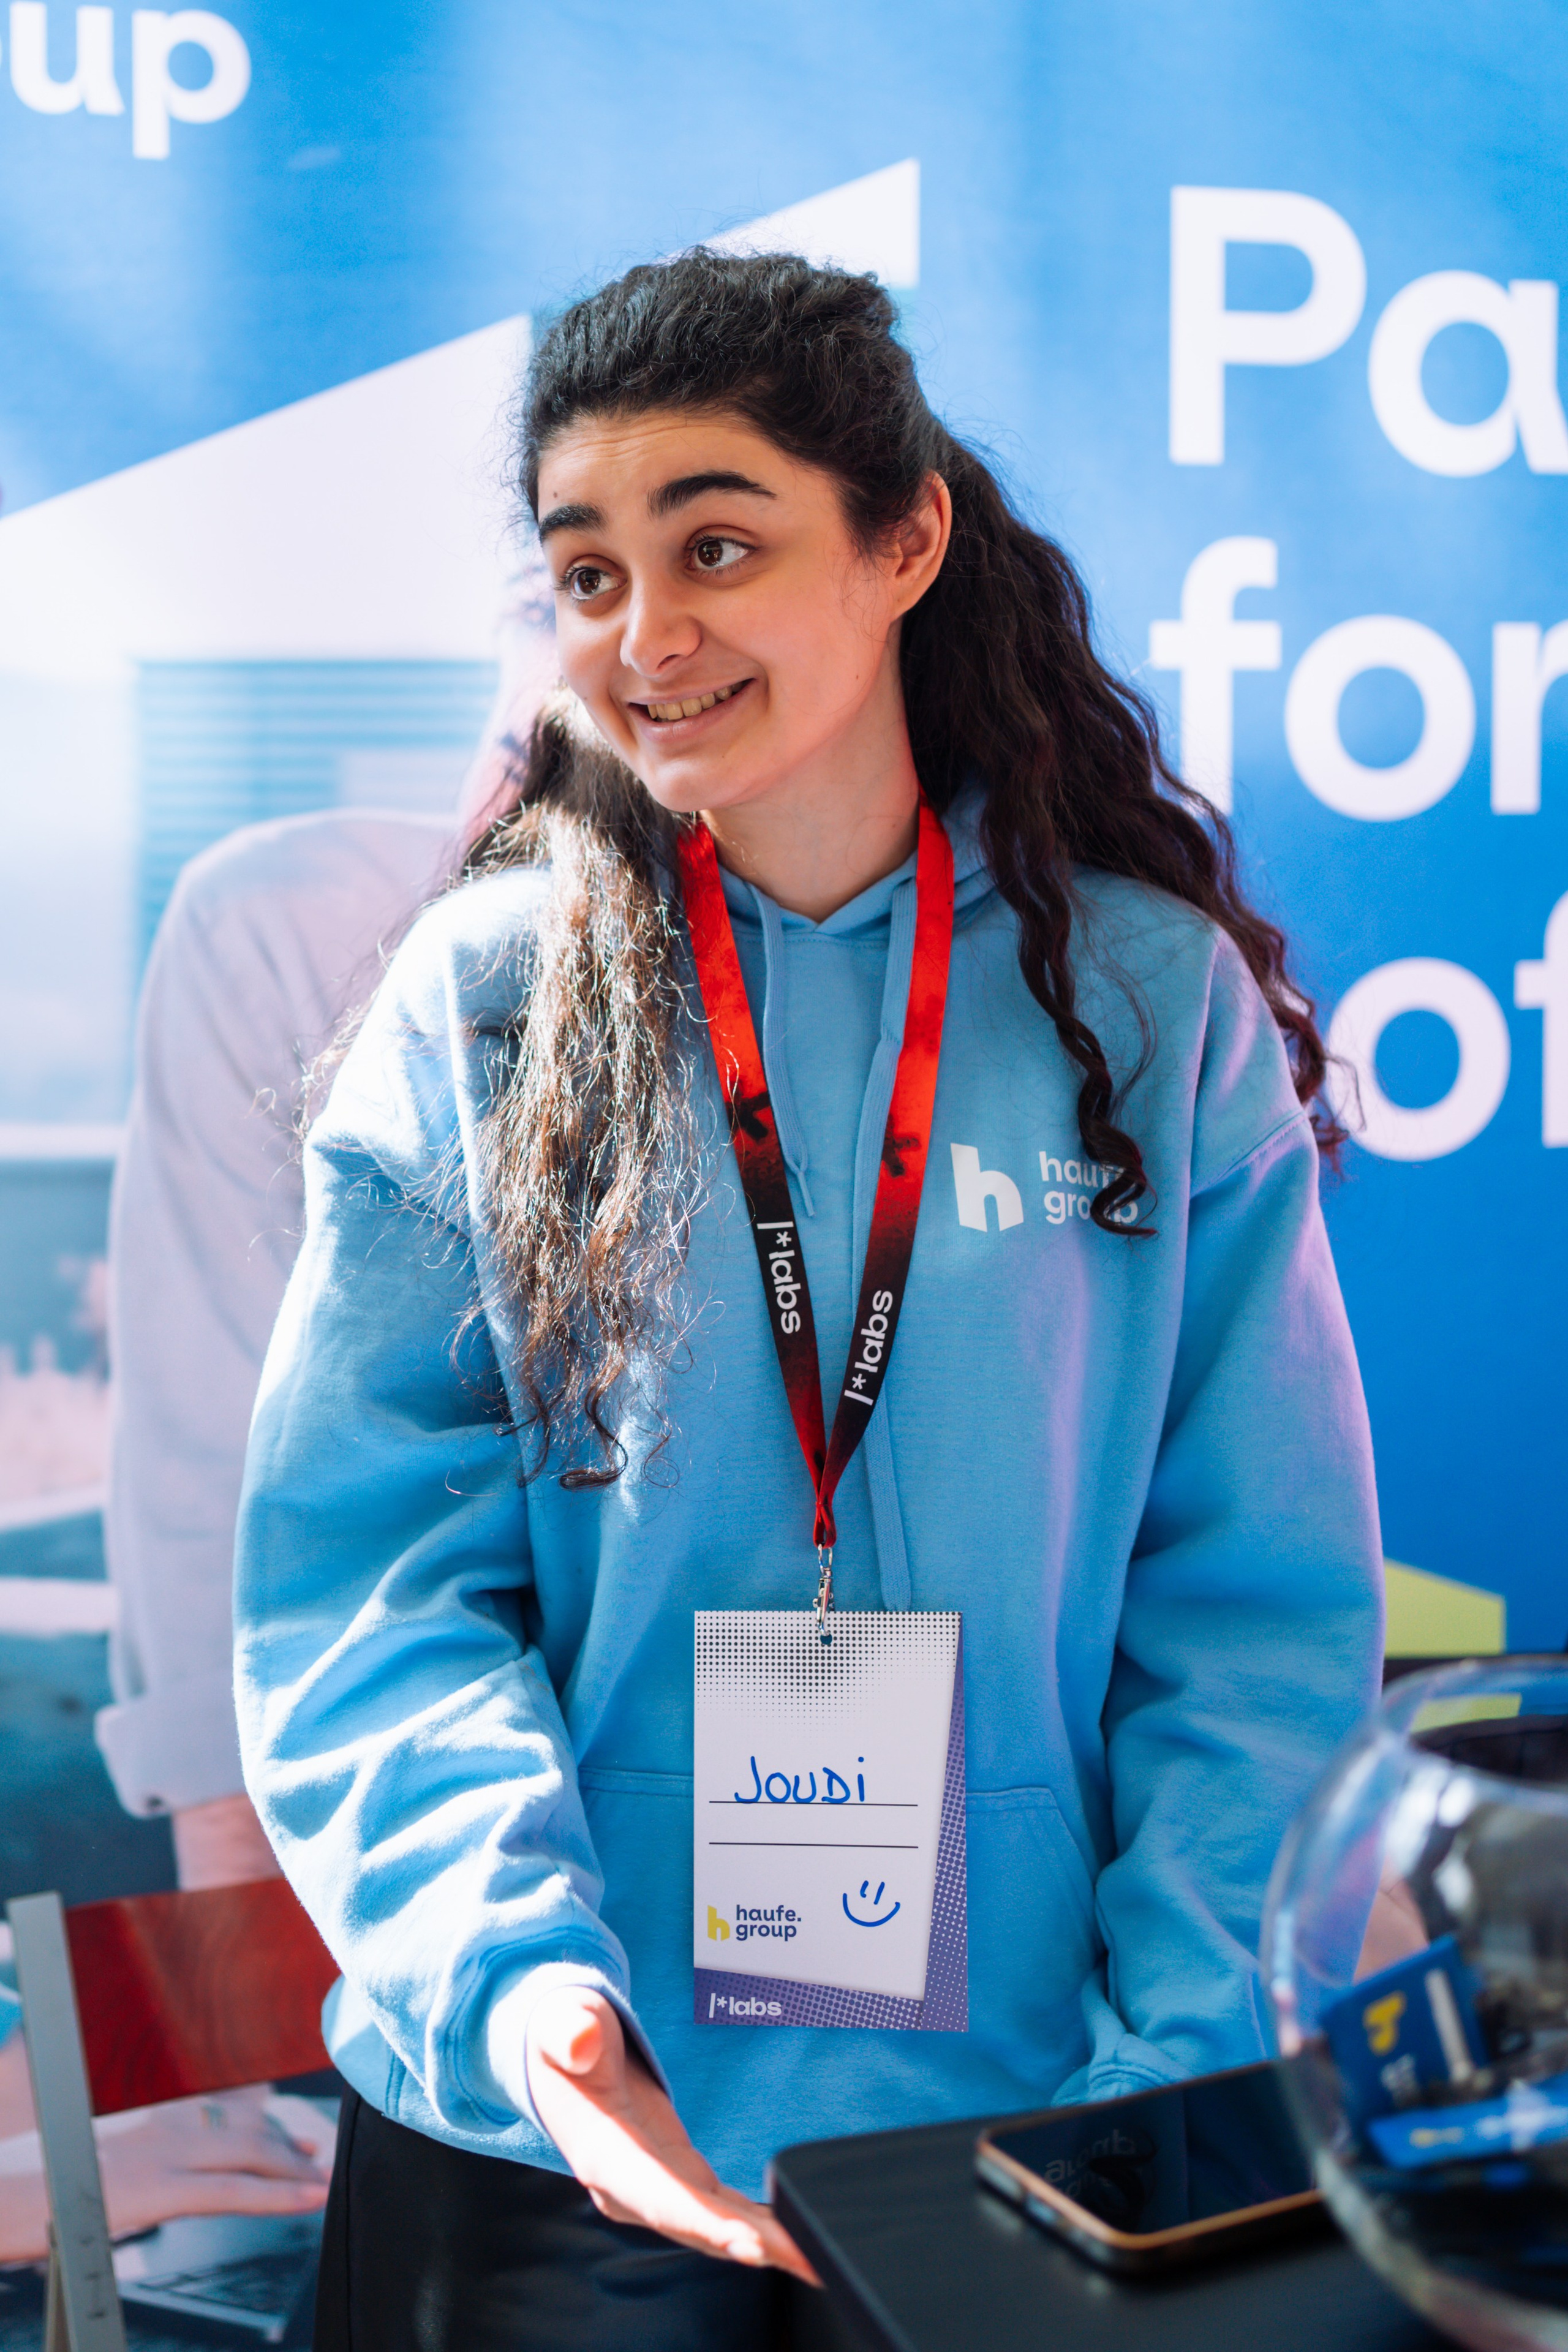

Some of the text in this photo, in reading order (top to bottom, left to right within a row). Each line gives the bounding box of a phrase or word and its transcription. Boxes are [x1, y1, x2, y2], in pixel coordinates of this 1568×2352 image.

[1169, 184, 1568, 478] Pa
[1149, 535, 1568, 822] for
[1044, 1191, 1139, 1225] grop
[736, 1904, 802, 1922] haufe.
[736, 1924, 797, 1942] group
